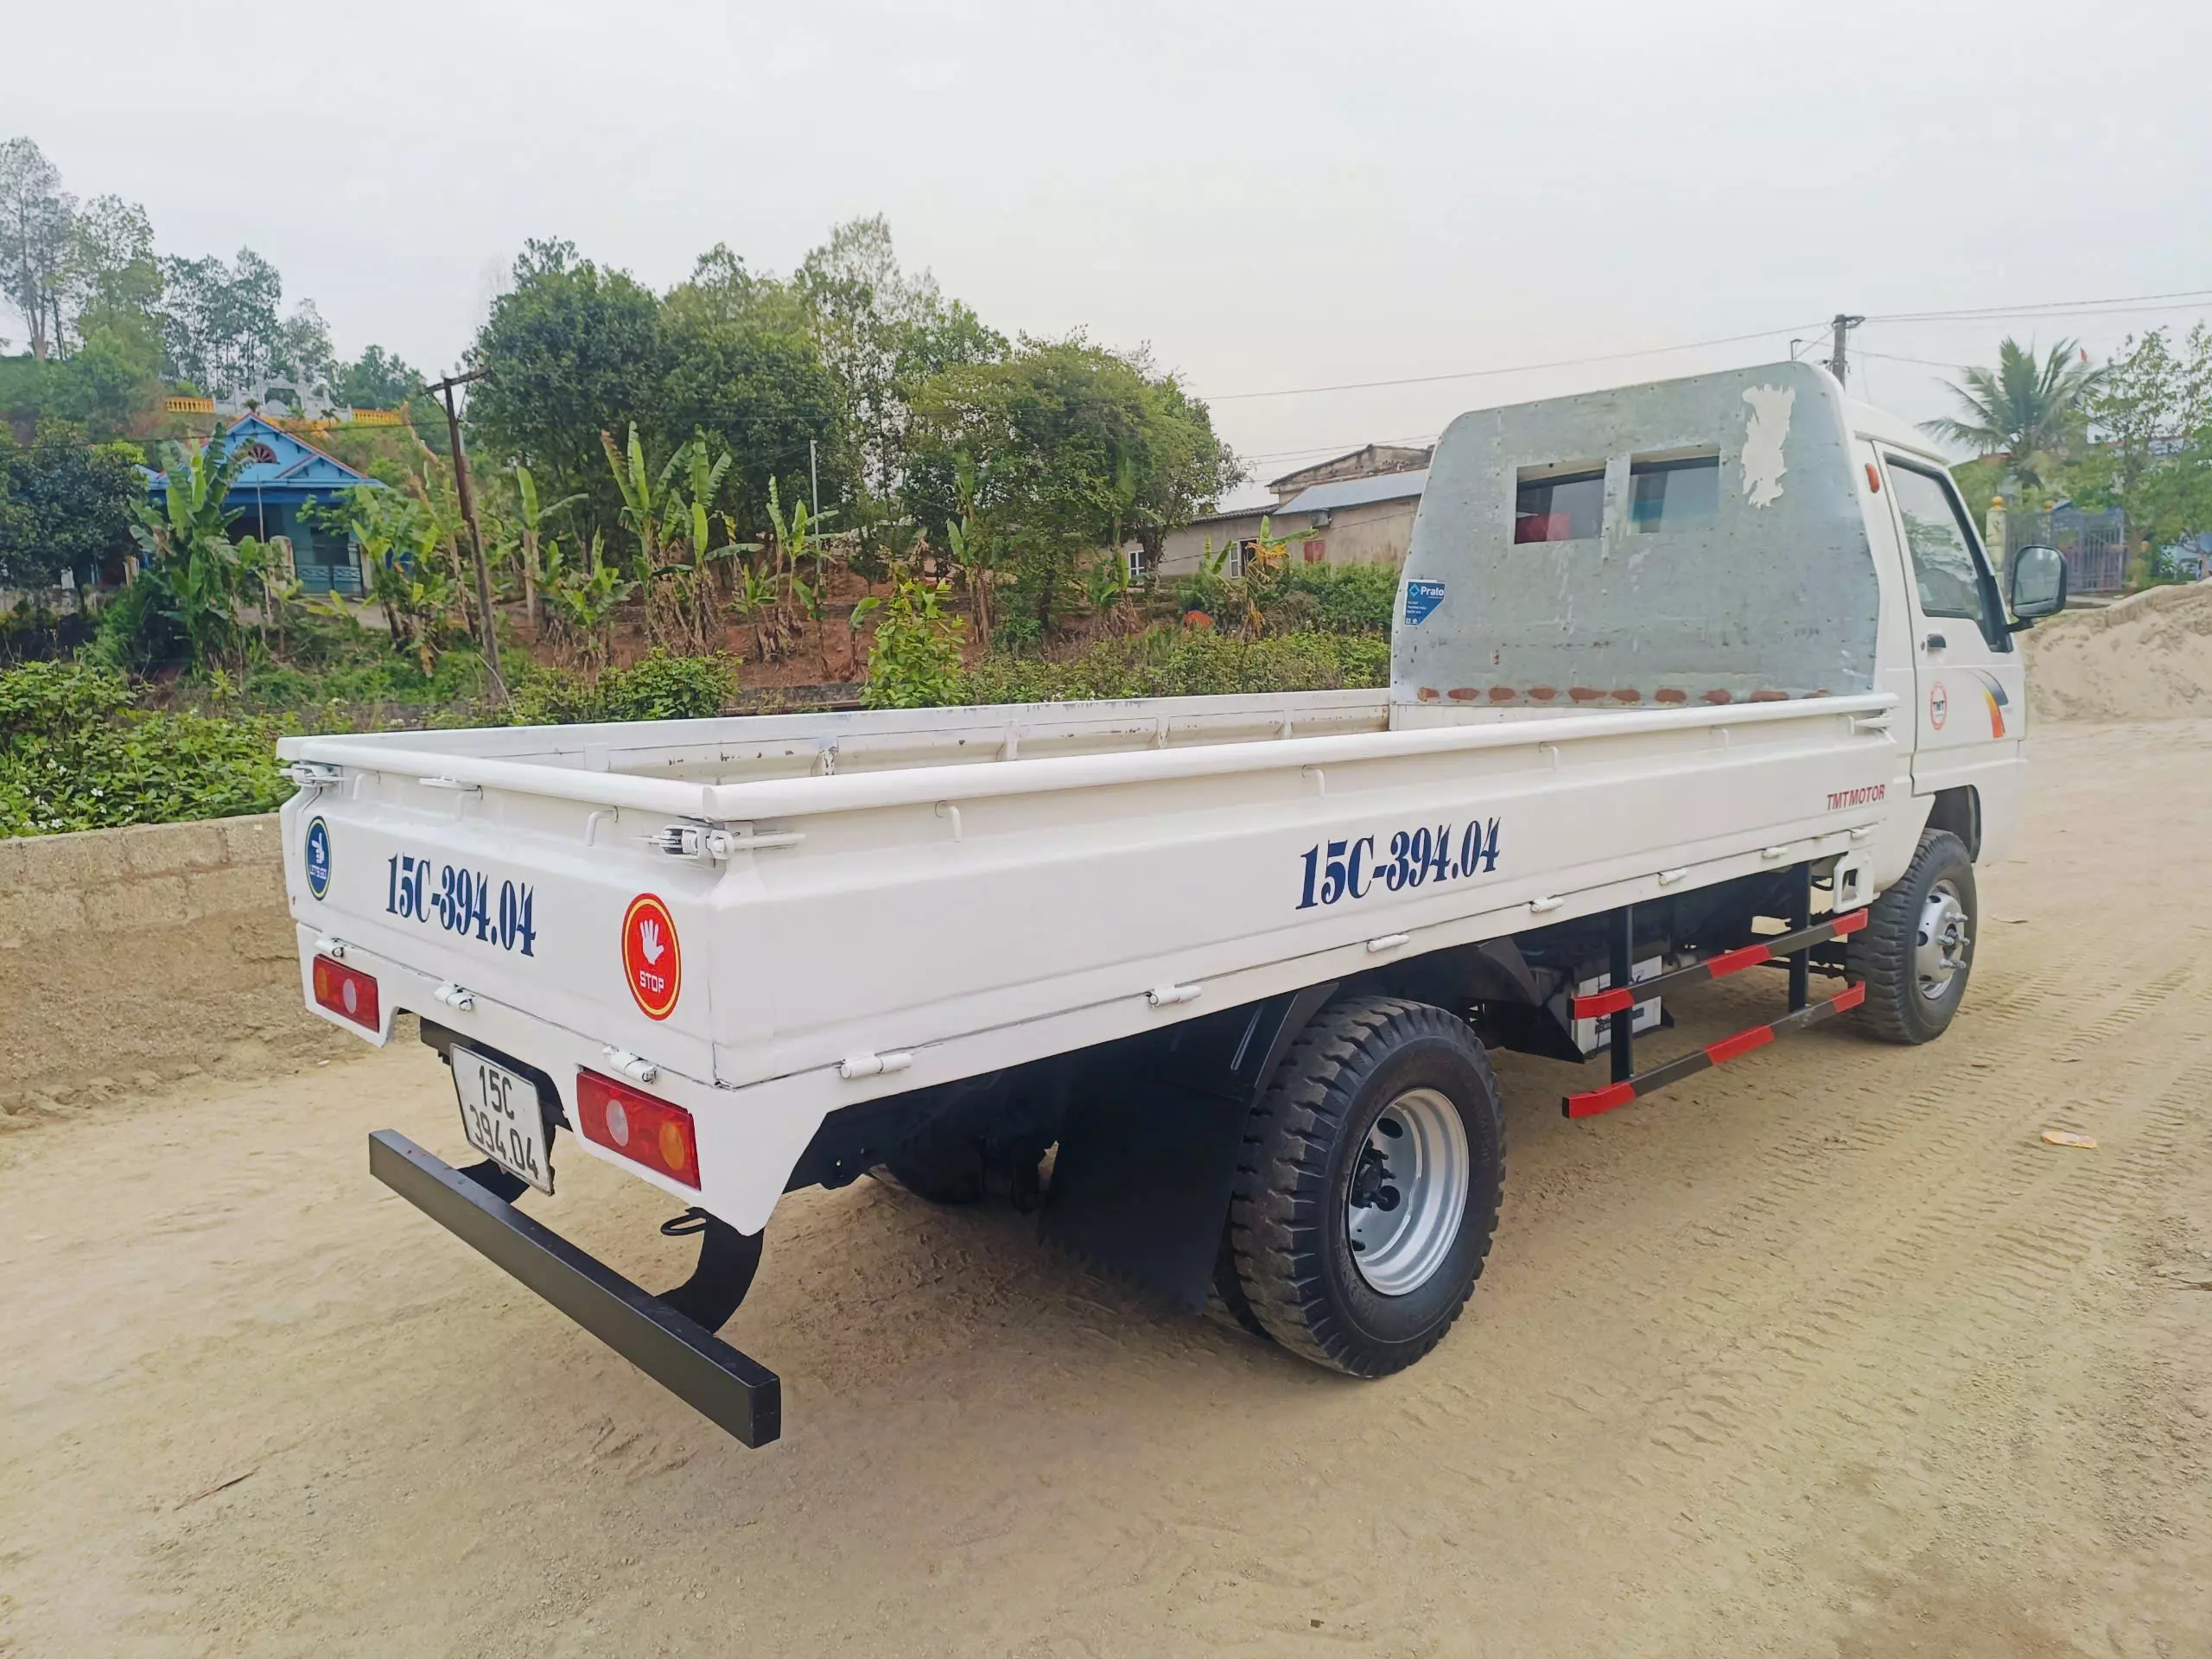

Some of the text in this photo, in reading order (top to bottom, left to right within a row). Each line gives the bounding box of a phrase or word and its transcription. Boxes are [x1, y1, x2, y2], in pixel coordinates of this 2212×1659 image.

[1295, 816, 1502, 910] 15C-394.04
[385, 852, 537, 957] 15C-394.04
[639, 969, 664, 994] STOP
[479, 1065, 515, 1120] 15C
[469, 1103, 539, 1180] 394.04
